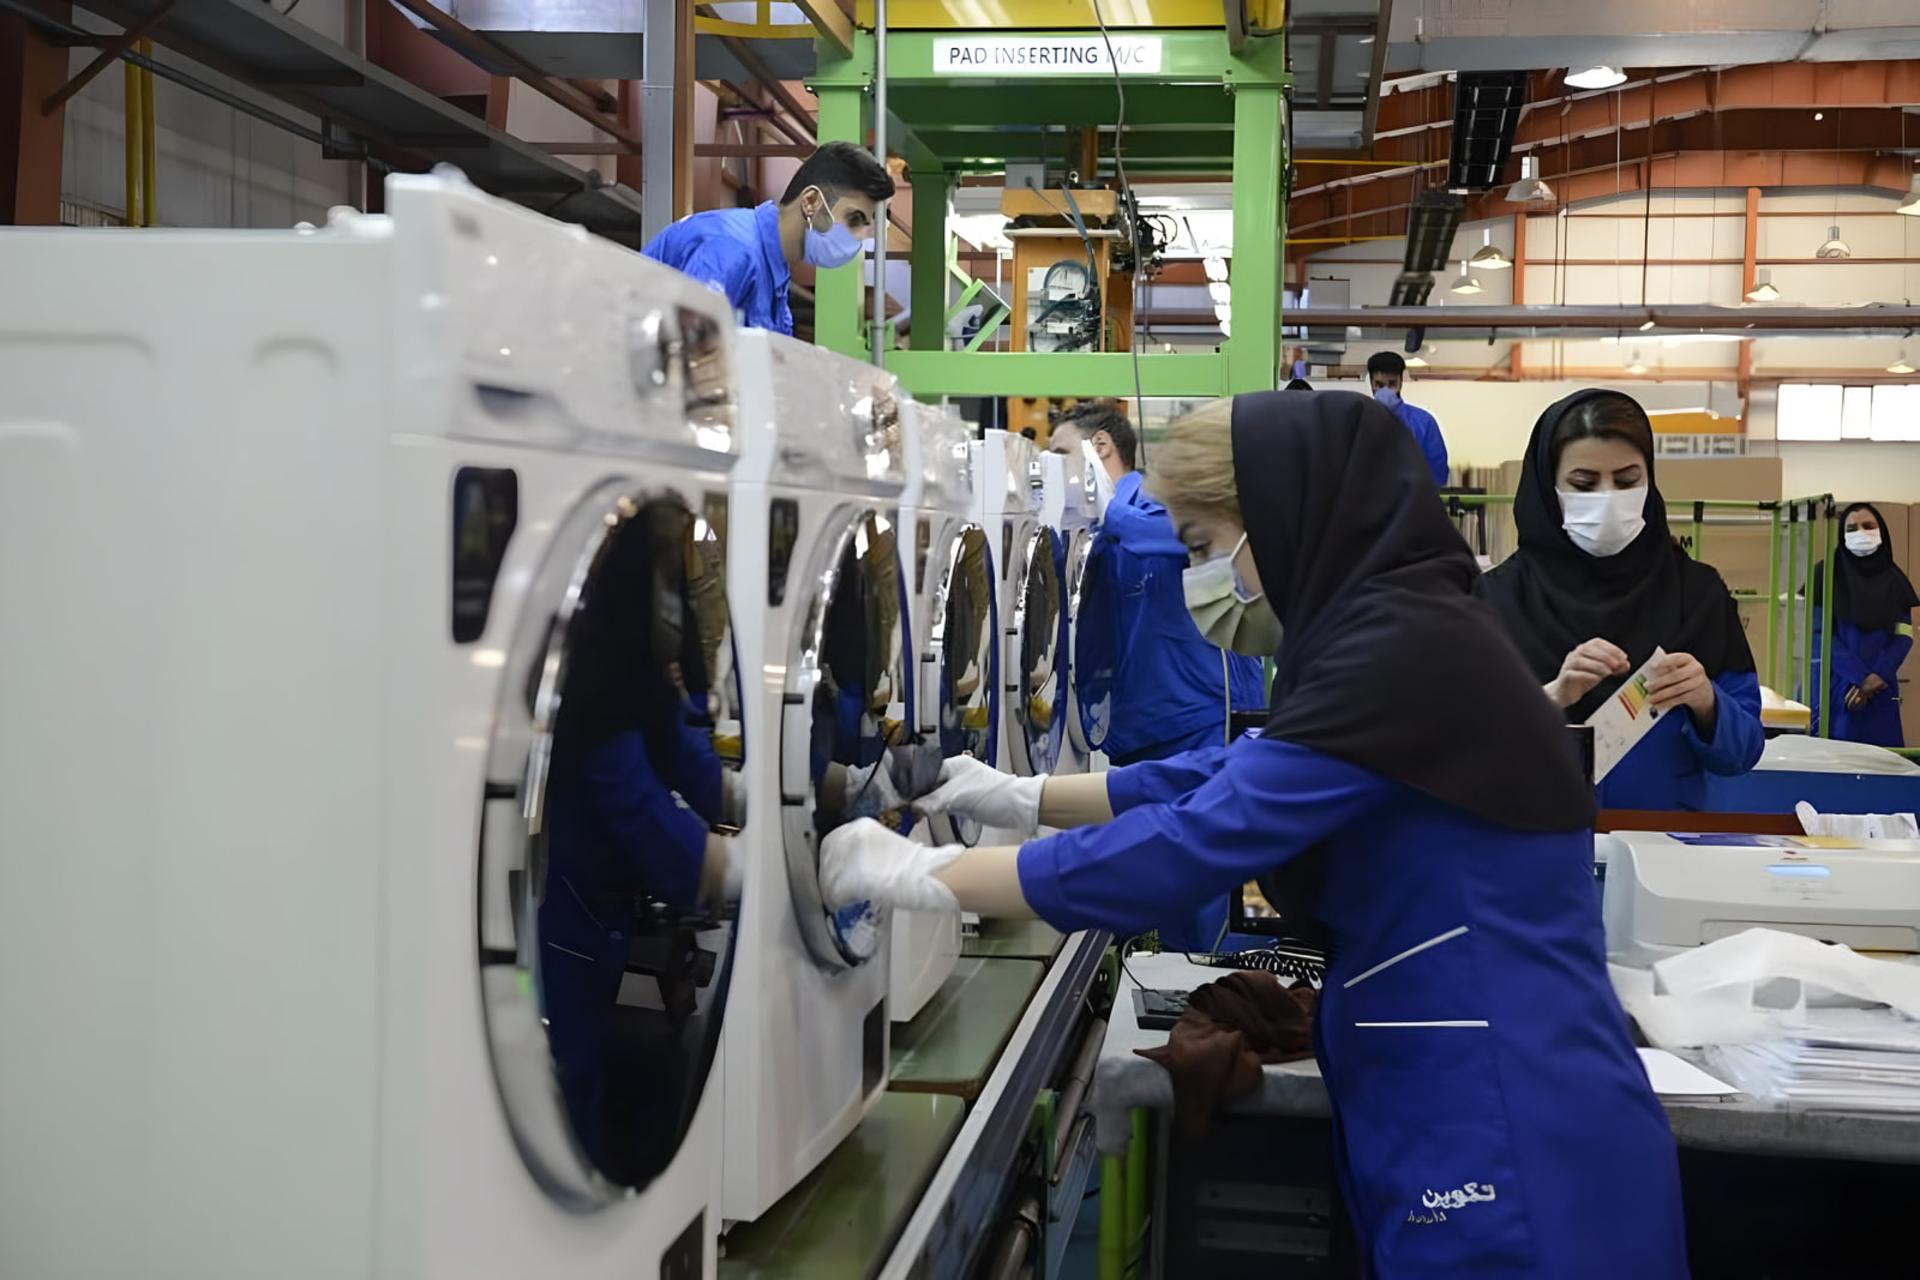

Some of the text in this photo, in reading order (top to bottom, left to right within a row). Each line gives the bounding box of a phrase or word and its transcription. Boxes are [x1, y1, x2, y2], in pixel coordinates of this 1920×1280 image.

[949, 46, 1145, 64] PAD INSERTING M/C
